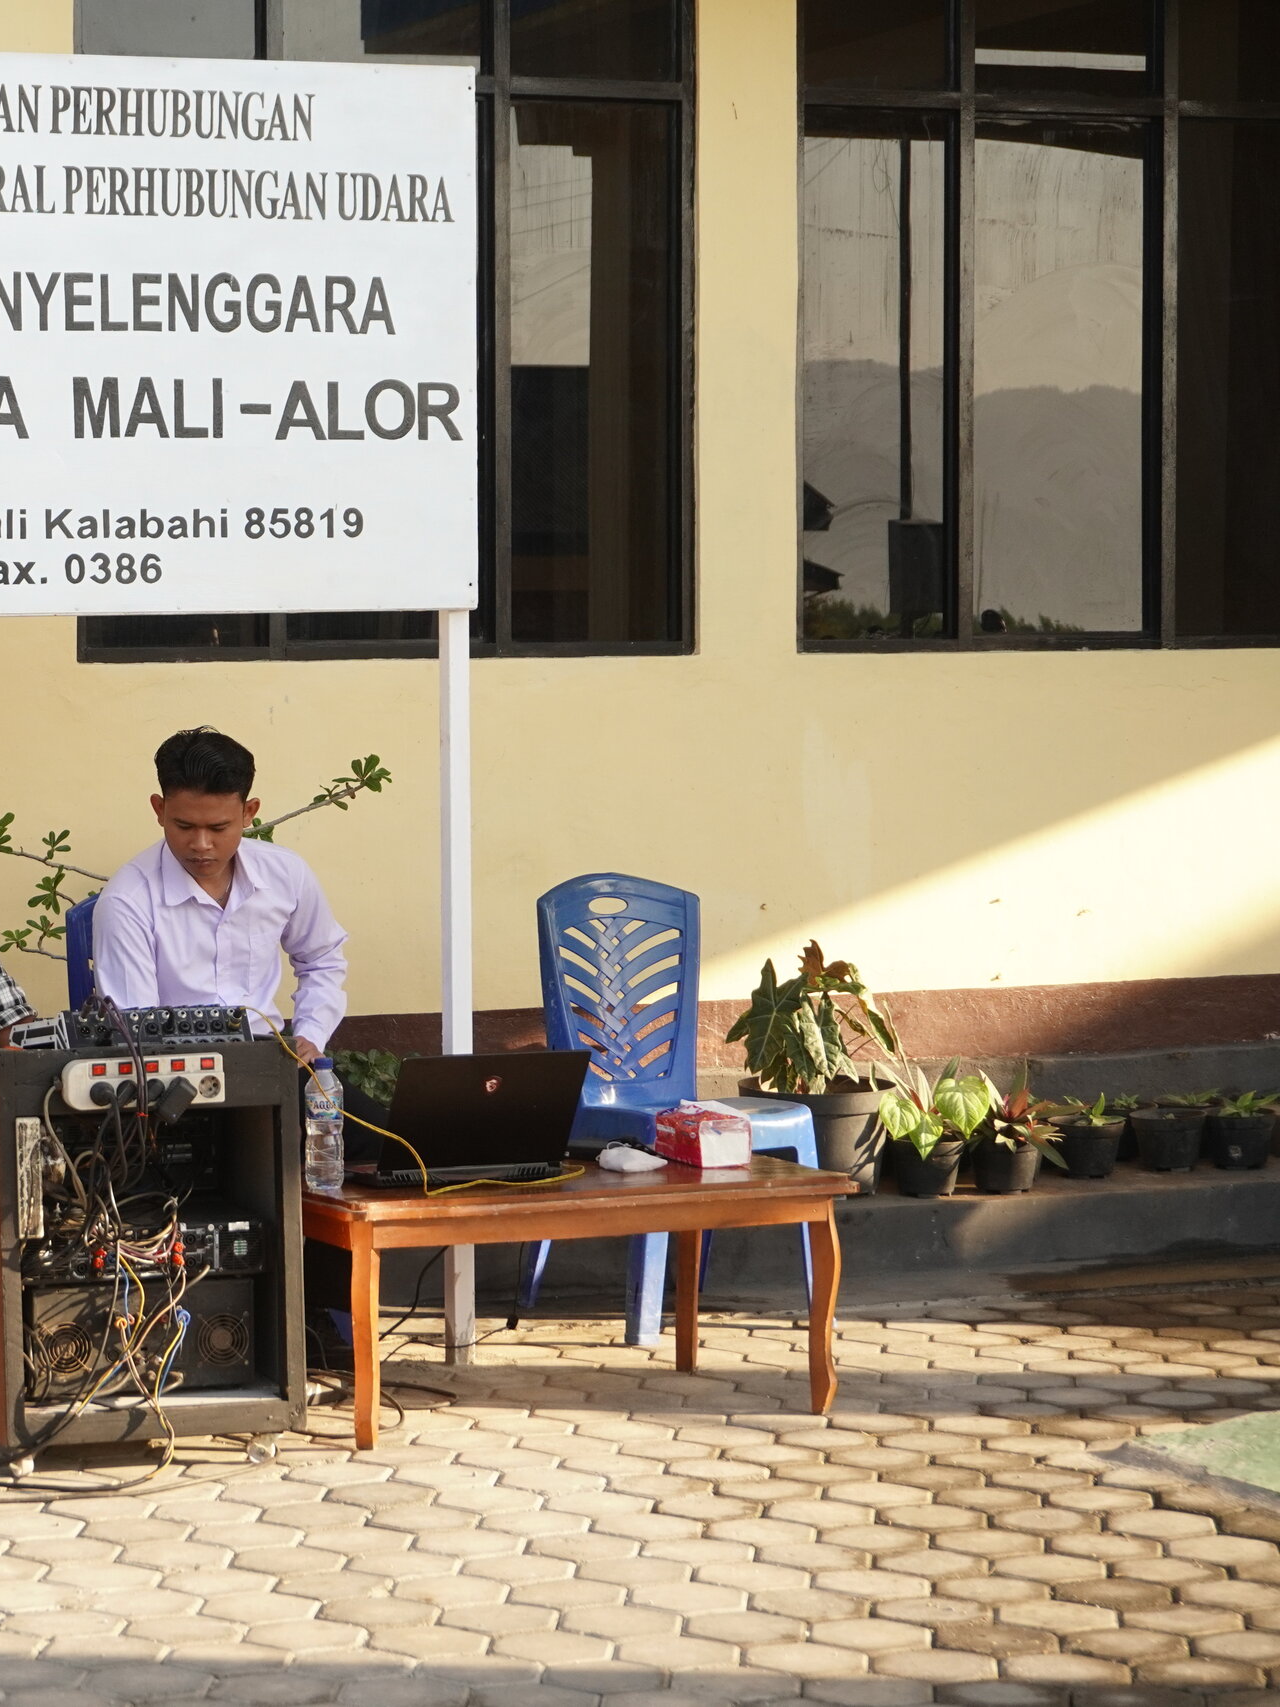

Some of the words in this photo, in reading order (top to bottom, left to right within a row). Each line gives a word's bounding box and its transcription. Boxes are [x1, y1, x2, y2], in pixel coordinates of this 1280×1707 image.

[49, 85, 315, 142] PERHUBUNGAN
[62, 165, 328, 221] PERHUBUNGAN
[336, 171, 455, 223] UDARA
[44, 507, 229, 540] Kalabahi
[243, 505, 365, 540] 85819
[63, 551, 163, 586] 0386
